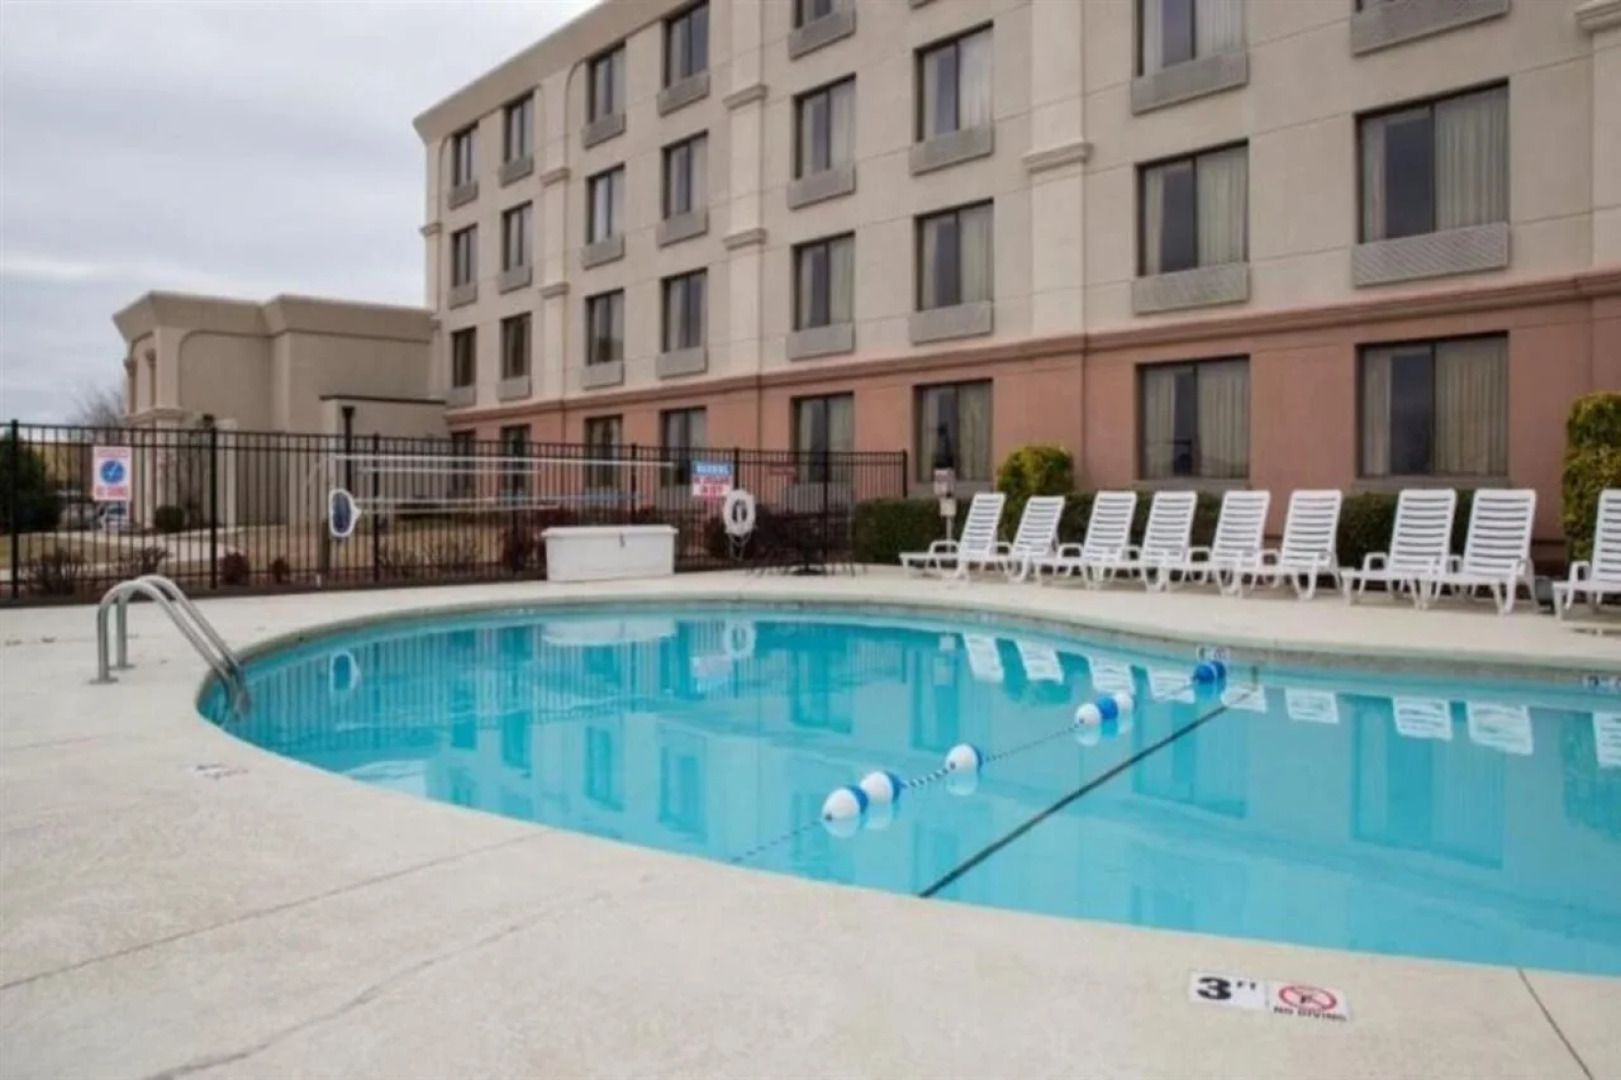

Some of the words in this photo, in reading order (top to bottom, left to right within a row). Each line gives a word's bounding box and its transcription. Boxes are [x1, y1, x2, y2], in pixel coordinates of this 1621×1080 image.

[1197, 977, 1231, 1000] 3
[1273, 1005, 1294, 1016] NO
[1297, 1008, 1348, 1022] DIVING
